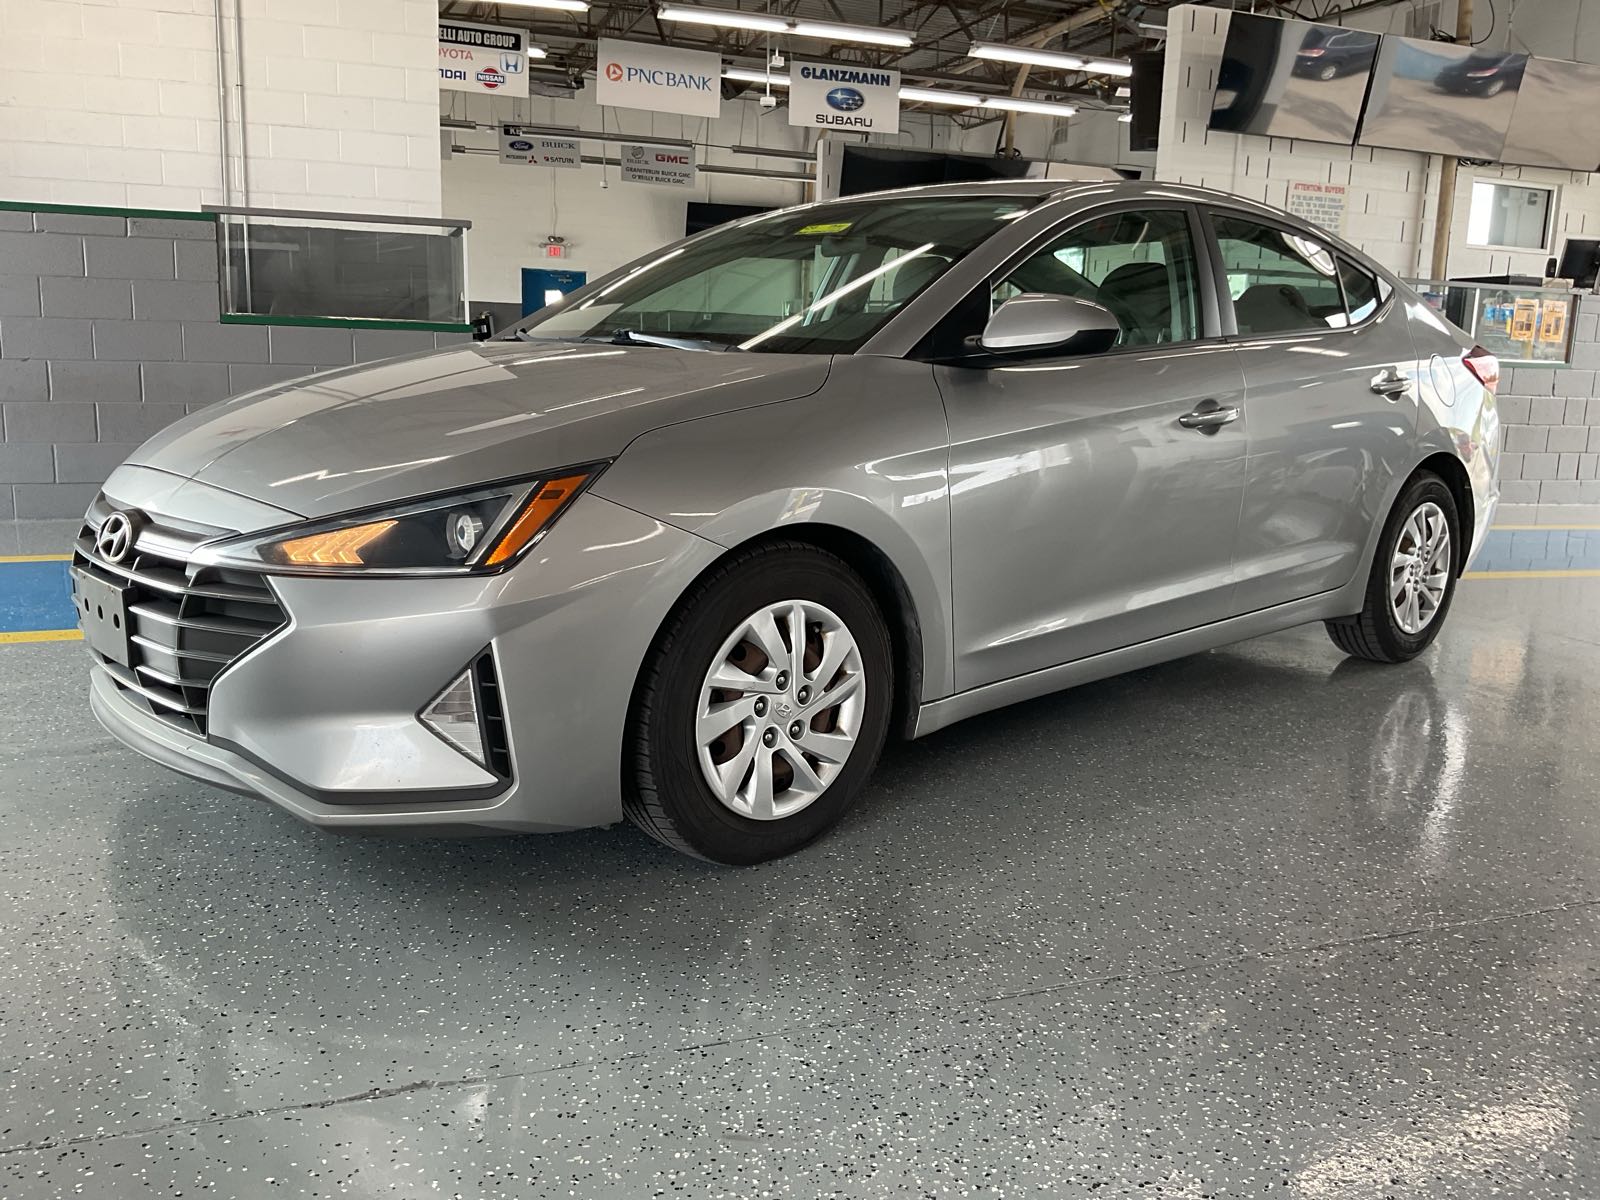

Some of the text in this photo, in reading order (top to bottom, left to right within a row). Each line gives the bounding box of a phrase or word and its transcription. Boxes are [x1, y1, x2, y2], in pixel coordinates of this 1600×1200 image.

[457, 29, 482, 44] AUTO
[483, 33, 516, 48] GROUP
[439, 48, 474, 60] YOTA
[477, 74, 504, 83] NISSAN
[800, 66, 891, 87] GLANZMANN
[815, 114, 873, 128] SUBARU
[541, 141, 576, 150] BUICK
[549, 156, 574, 164] SATURN
[655, 153, 689, 165] GMC
